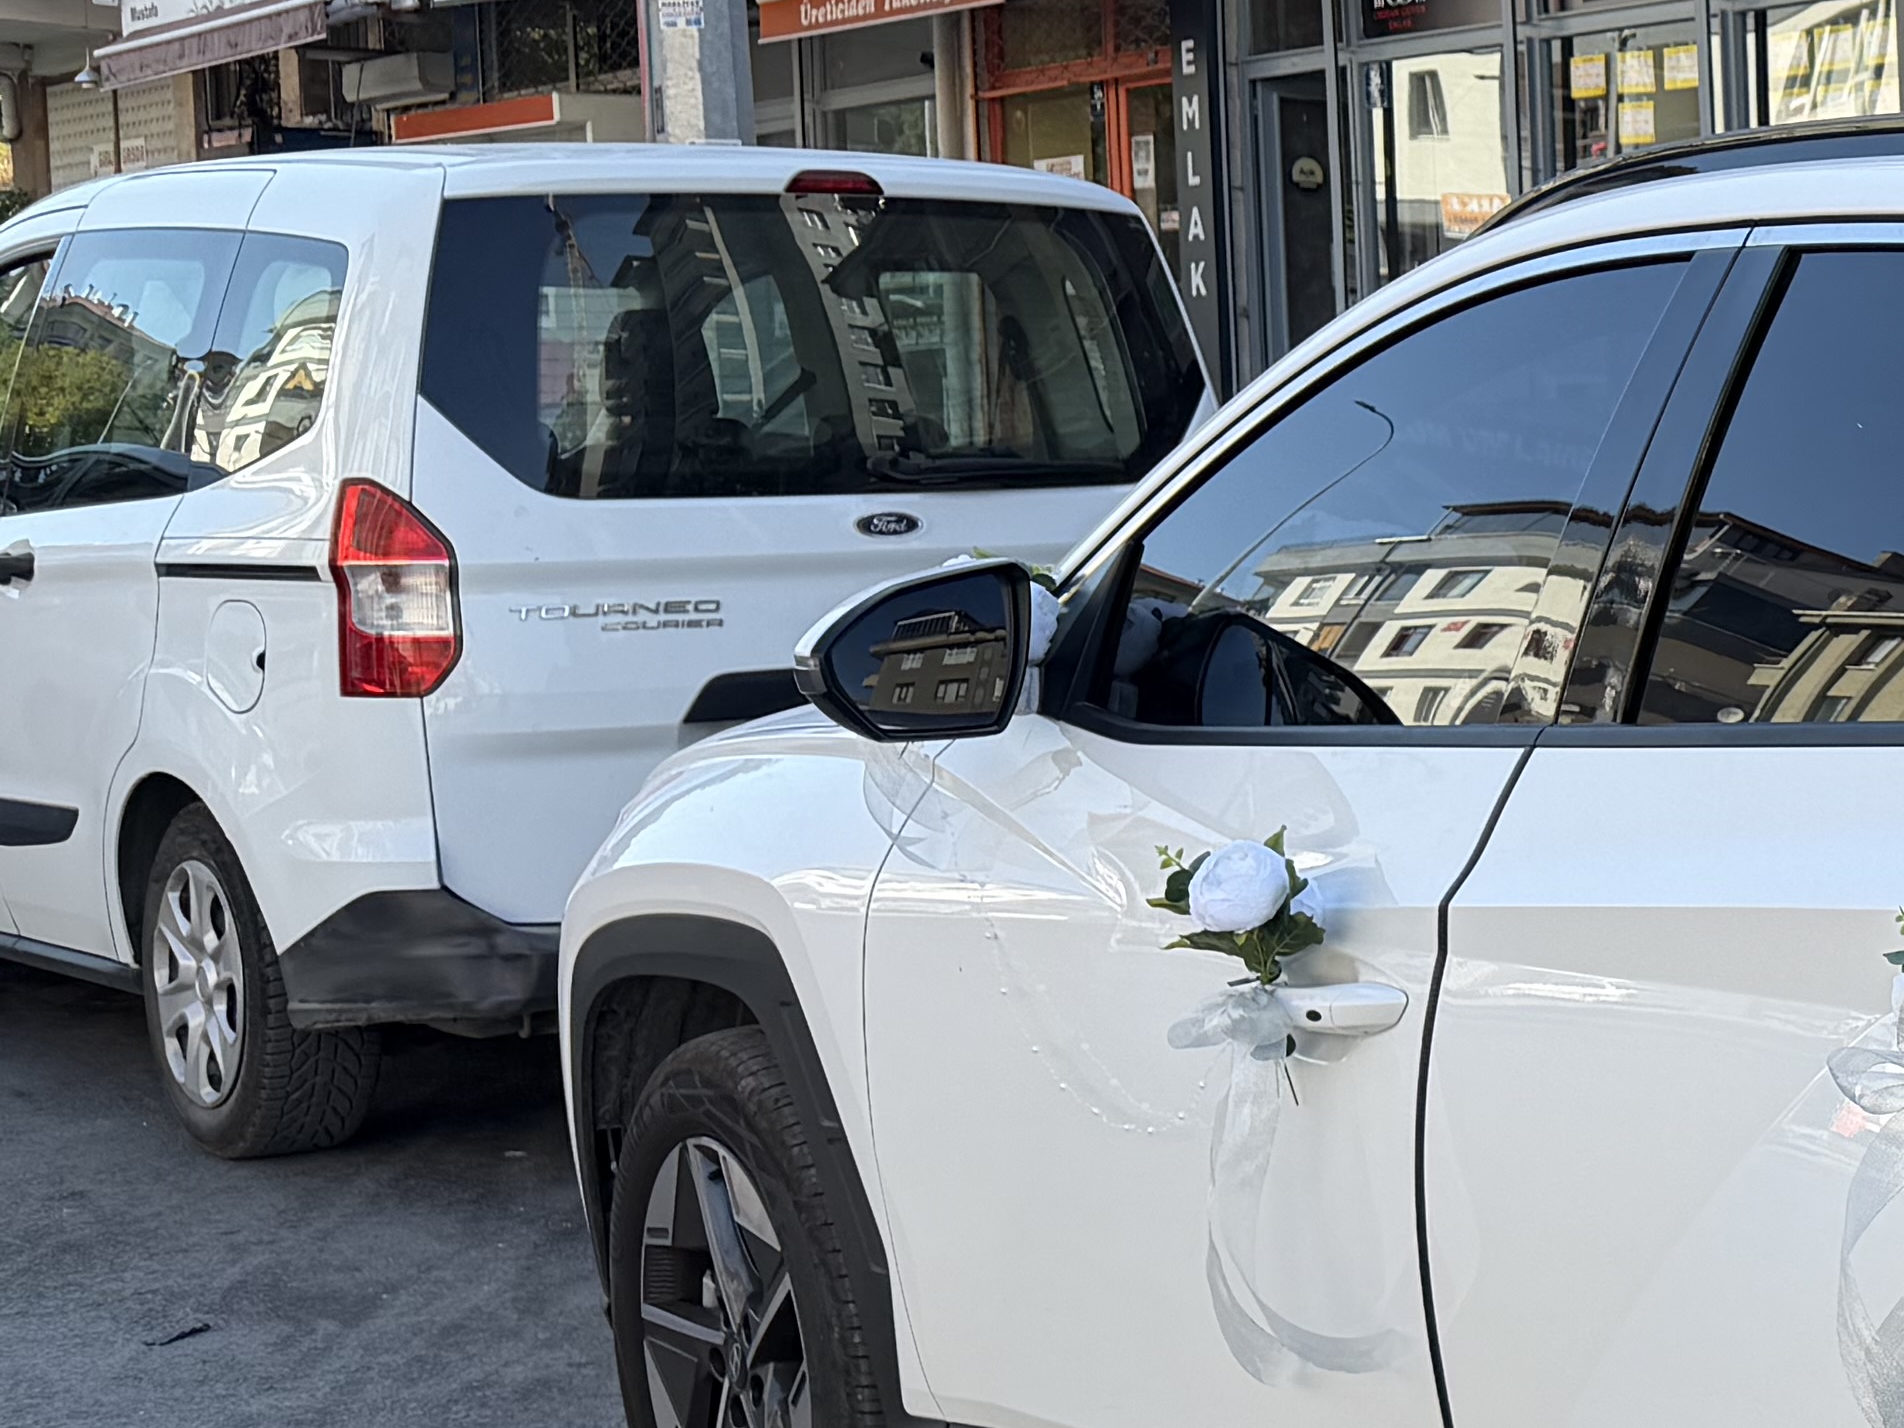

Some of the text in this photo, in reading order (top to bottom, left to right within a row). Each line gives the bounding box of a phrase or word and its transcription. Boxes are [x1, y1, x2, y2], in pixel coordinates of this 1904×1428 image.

[1180, 38, 1207, 298] EMLAK
[870, 511, 909, 536] Ford
[509, 599, 722, 621] TOURNEO
[601, 617, 724, 632] COURIER
